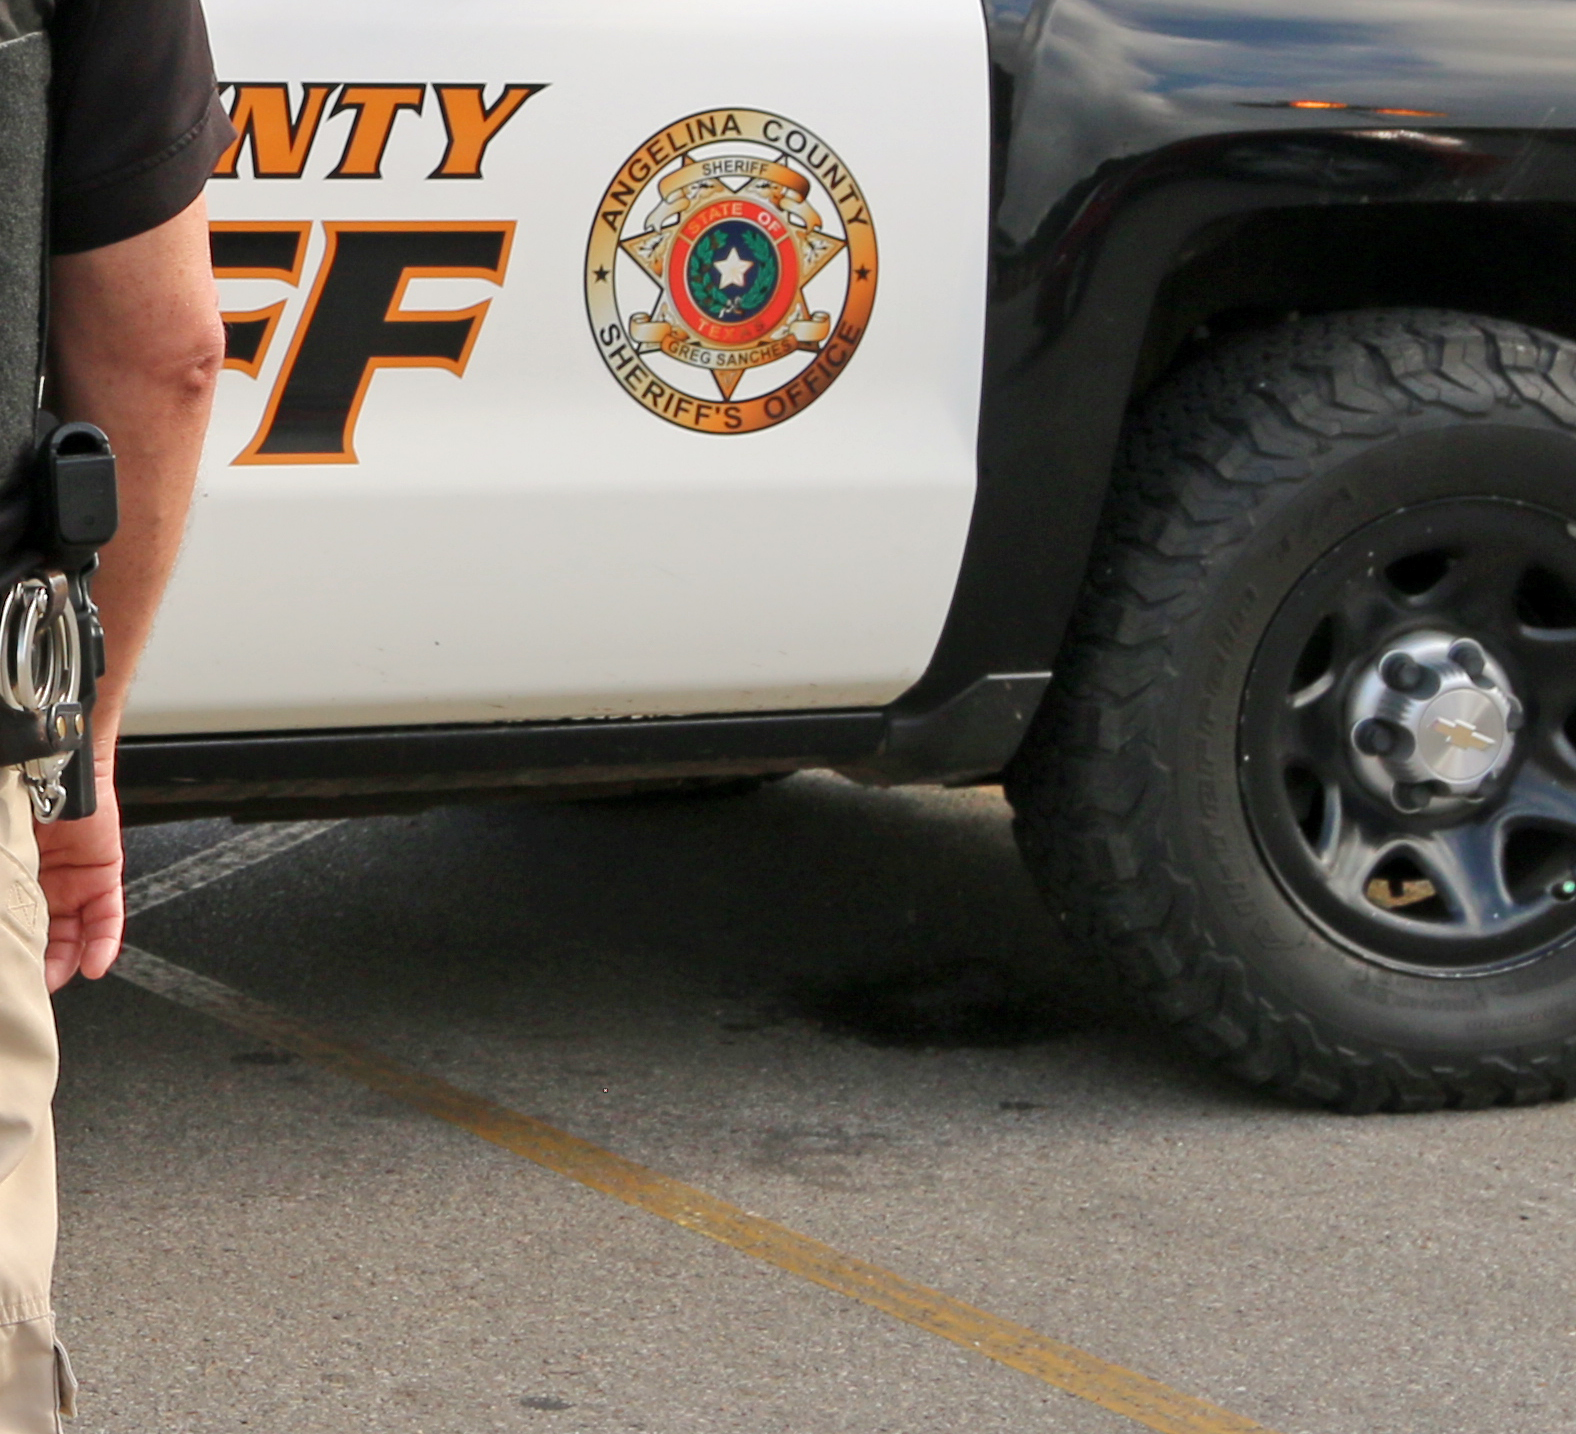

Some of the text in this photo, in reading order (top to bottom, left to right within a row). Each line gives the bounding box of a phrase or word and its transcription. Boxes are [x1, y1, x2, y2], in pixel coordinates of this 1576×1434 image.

[210, 81, 552, 180] NTY
[601, 113, 868, 233] ANGELINA COUNTY
[702, 159, 768, 176] SHERIFF
[689, 202, 781, 234] STATE OF
[698, 318, 765, 339] TEXAS
[668, 341, 711, 364] GREG
[600, 321, 862, 429] SHERIFF'S OFFICE
